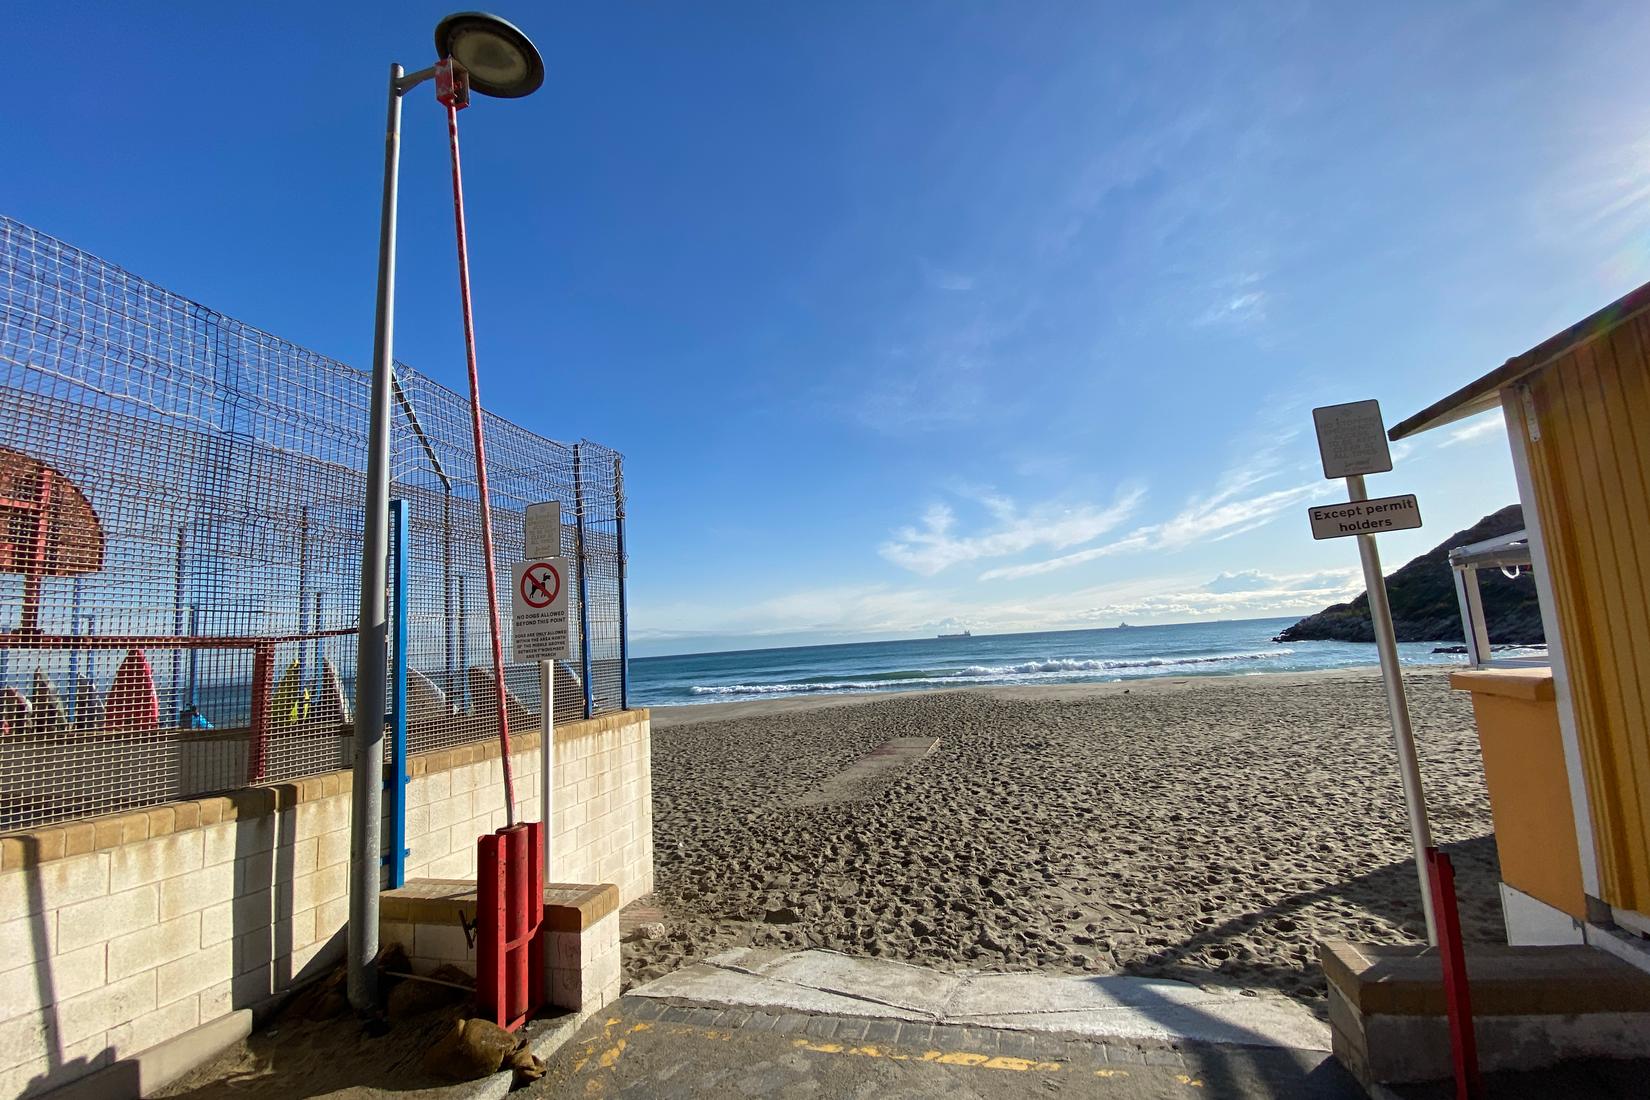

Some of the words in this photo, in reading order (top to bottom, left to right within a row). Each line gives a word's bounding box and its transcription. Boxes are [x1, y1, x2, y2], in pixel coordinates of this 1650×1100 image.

[1314, 506, 1362, 520] Except
[1366, 499, 1414, 516] permit
[1339, 518, 1393, 532] holders
